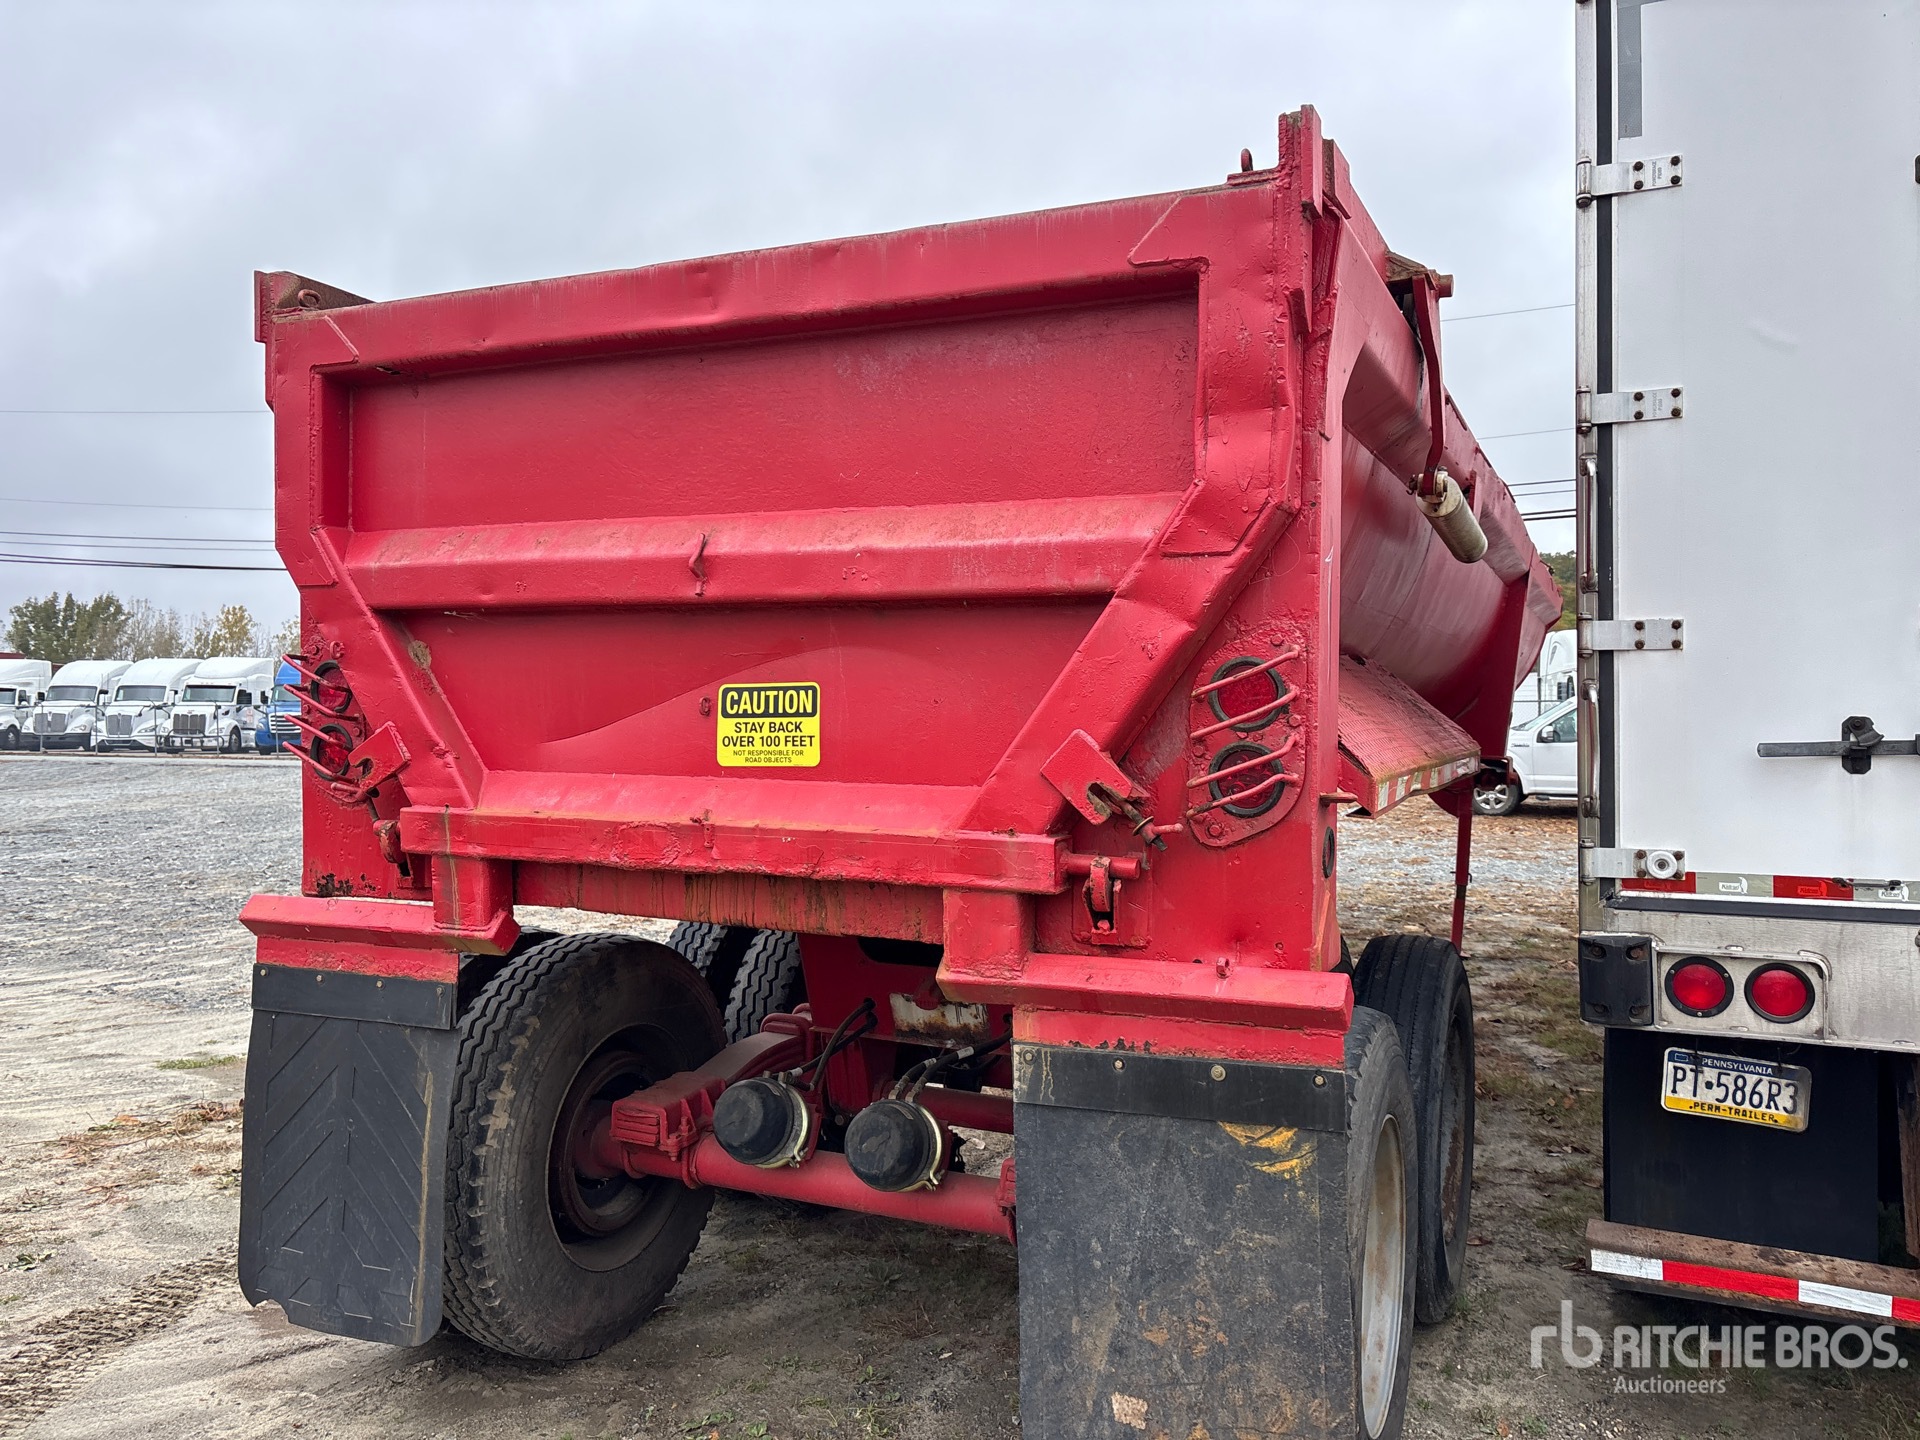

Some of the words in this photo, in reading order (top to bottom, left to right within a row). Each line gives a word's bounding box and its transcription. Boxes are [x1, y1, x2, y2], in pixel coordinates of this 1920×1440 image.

[726, 690, 813, 715] CAUTION
[734, 722, 765, 734] STAY
[769, 721, 803, 733] BACK
[722, 736, 755, 747] OVER
[760, 736, 780, 747] 100
[785, 735, 815, 747] FEET
[1702, 1057, 1773, 1075] PENNSYLVANIA
[1693, 1102, 1775, 1122] PERM-TRAILER
